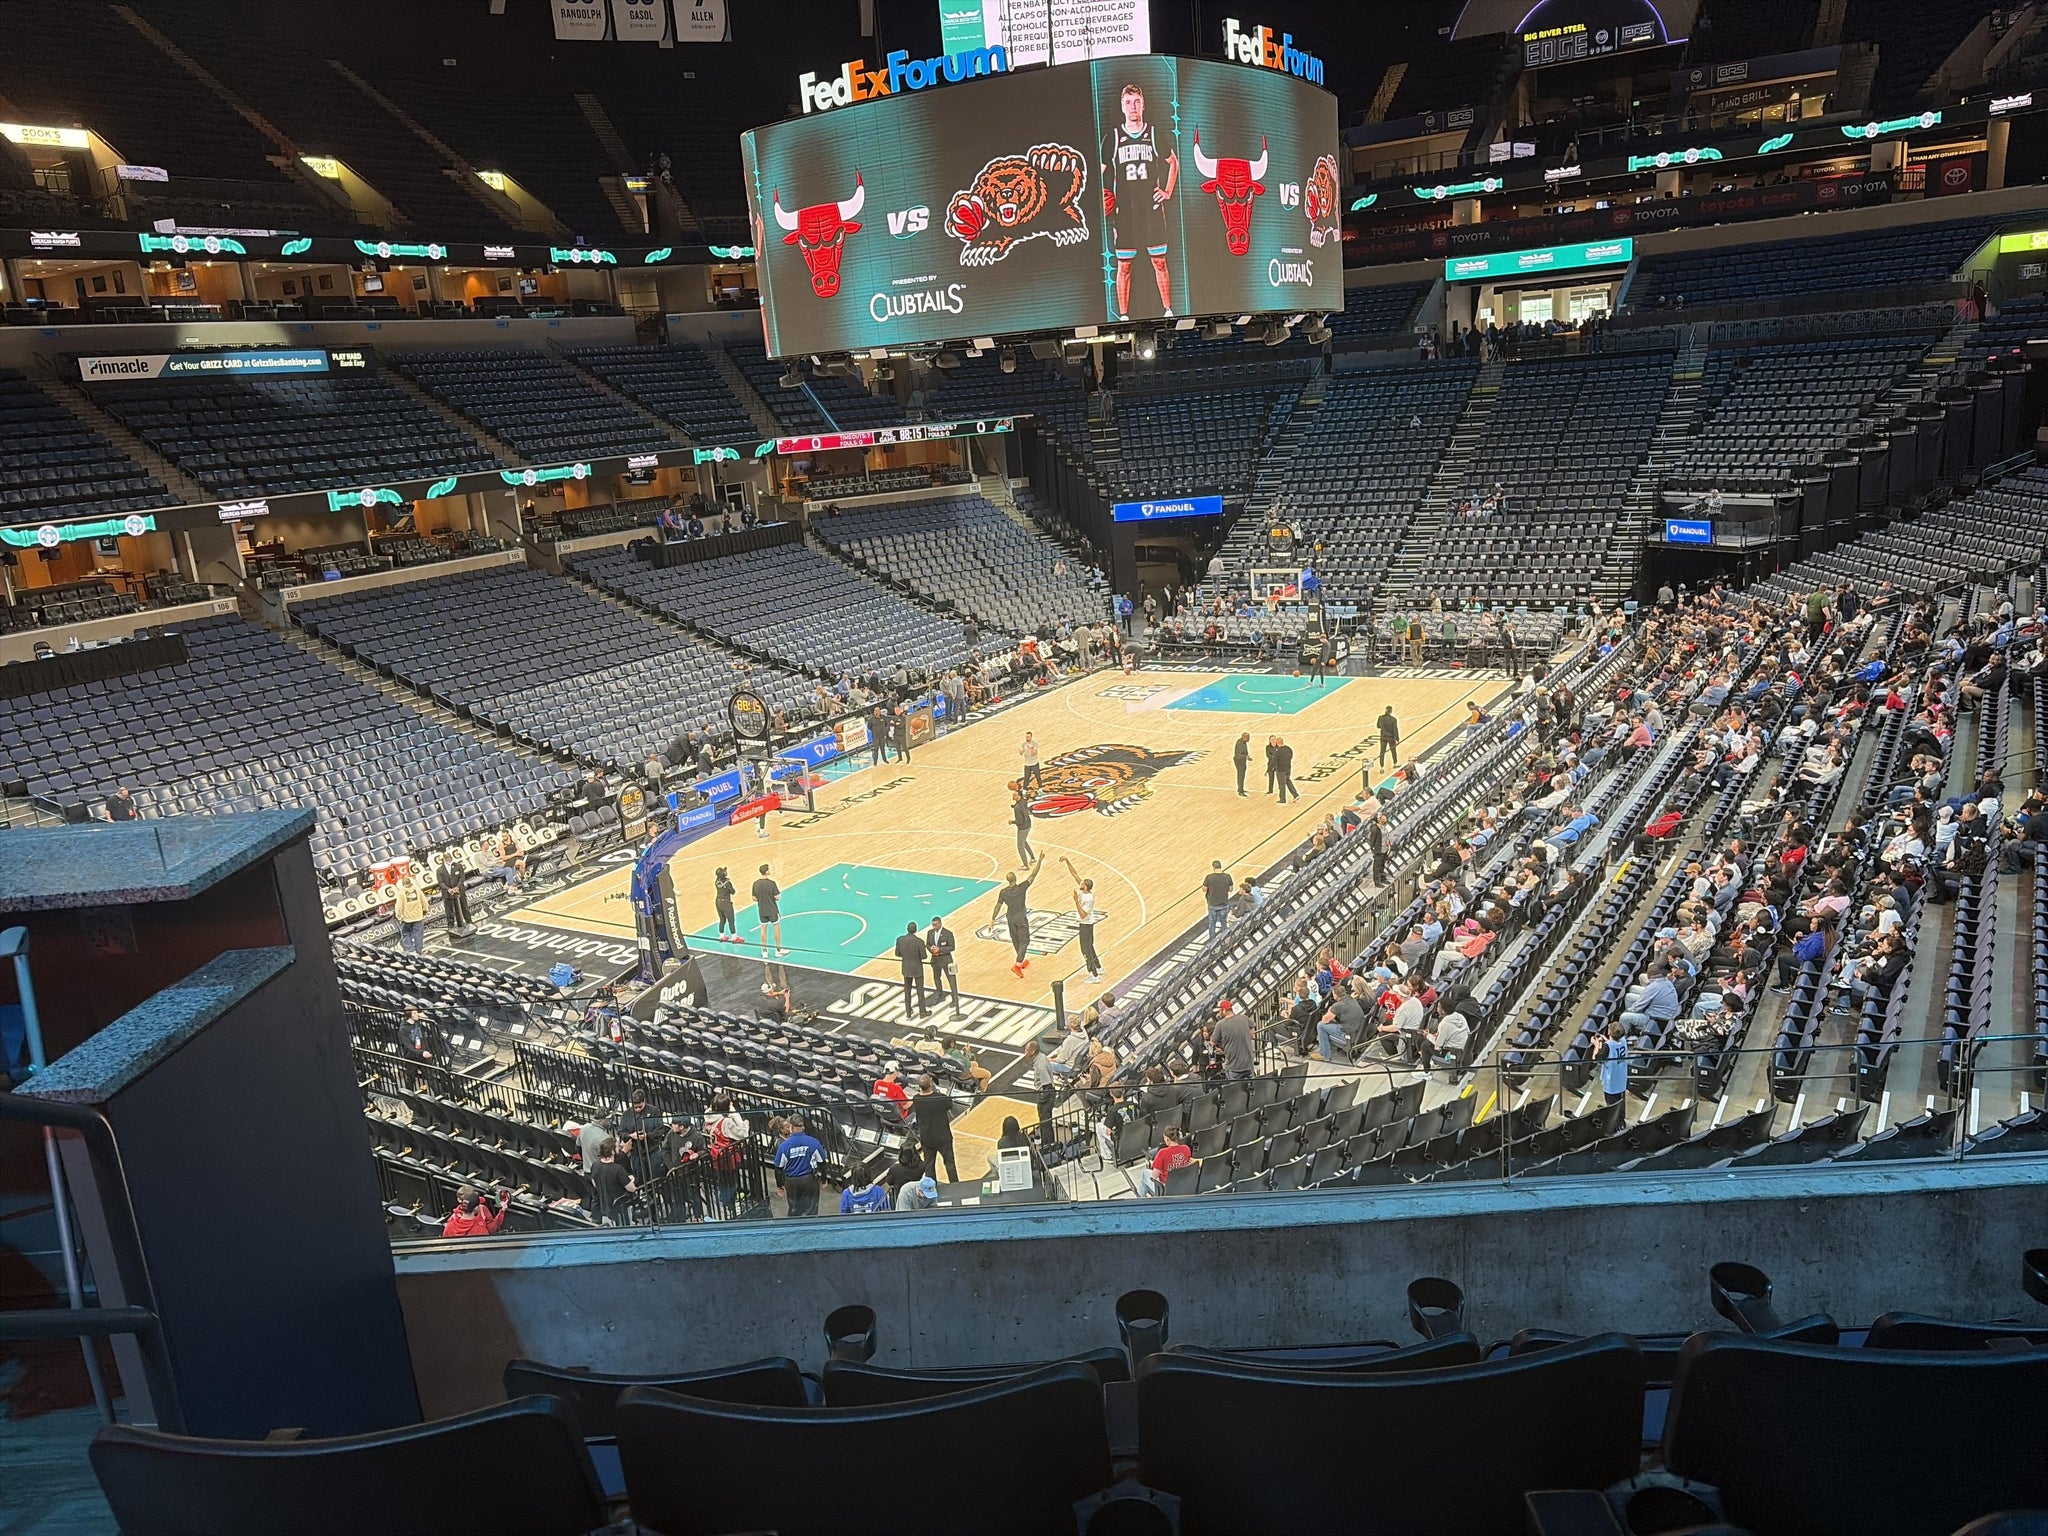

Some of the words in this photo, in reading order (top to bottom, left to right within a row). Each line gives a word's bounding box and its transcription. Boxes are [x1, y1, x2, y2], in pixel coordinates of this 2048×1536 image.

[1007, 1, 1022, 10] PER
[1023, 0, 1041, 9] NBA
[1014, 11, 1036, 21] CAPS
[1036, 10, 1047, 18] OF
[1050, 4, 1117, 17] NON-ALCOHOLIC
[1117, 1, 1136, 10] AND
[560, 8, 602, 20] RANDOLPH
[629, 10, 654, 21] GASOL
[691, 11, 714, 22] ALLEN
[1051, 17, 1085, 28] BOTTLED
[1086, 12, 1134, 25] BEVERAGES
[1007, 34, 1024, 43] ARE
[1024, 31, 1064, 42] REQUIED
[1065, 29, 1077, 37] TO
[1089, 24, 1130, 35] REMOVED
[1523, 32, 1538, 42] BIG
[1538, 27, 1562, 40] RIVER
[1563, 23, 1587, 35] STEEL
[1036, 41, 1061, 51] BEIG
[1061, 40, 1083, 49] SOLD
[1097, 34, 1134, 46] PATRONS
[1225, 17, 1324, 86] FedExForum
[1525, 32, 1588, 67] EDGE
[799, 45, 1007, 114] FedExForum
[1742, 89, 1771, 104] GRILL
[22, 128, 61, 139] COOK'S
[1118, 144, 1153, 164] MEMPHIS
[1125, 163, 1148, 180] 24
[1814, 166, 1835, 174] TOYOTA
[1280, 183, 1300, 206] VS
[1635, 206, 1680, 221] TOYOTA
[886, 206, 930, 235] VS
[1452, 231, 1491, 245] TOYOTA
[891, 276, 928, 286] PRESENTED
[928, 274, 938, 282] BY
[331, 353, 346, 361] PLAY
[346, 352, 362, 360] HARD
[87, 358, 150, 375] Pinnacle
[169, 361, 184, 371] Get
[184, 360, 200, 370] Your
[200, 360, 222, 370] GRIZZ
[223, 359, 243, 368] CARD
[243, 359, 251, 367] at
[340, 359, 354, 367] Bank
[353, 359, 366, 368] Easy
[976, 421, 986, 433] 0
[811, 438, 822, 449] 0
[1155, 503, 1195, 514] FANDUEL
[1679, 527, 1707, 536] FANDUEL
[508, 552, 521, 560] 105
[285, 590, 299, 600] 105
[217, 602, 230, 611] 106
[1140, 664, 1273, 675] Robinhood
[667, 906, 684, 950] Robinhood
[660, 979, 687, 1001] Auto
[1615, 1045, 1627, 1058] 12
[789, 1146, 809, 1155] BEST
[1171, 1152, 1185, 1164] NO
